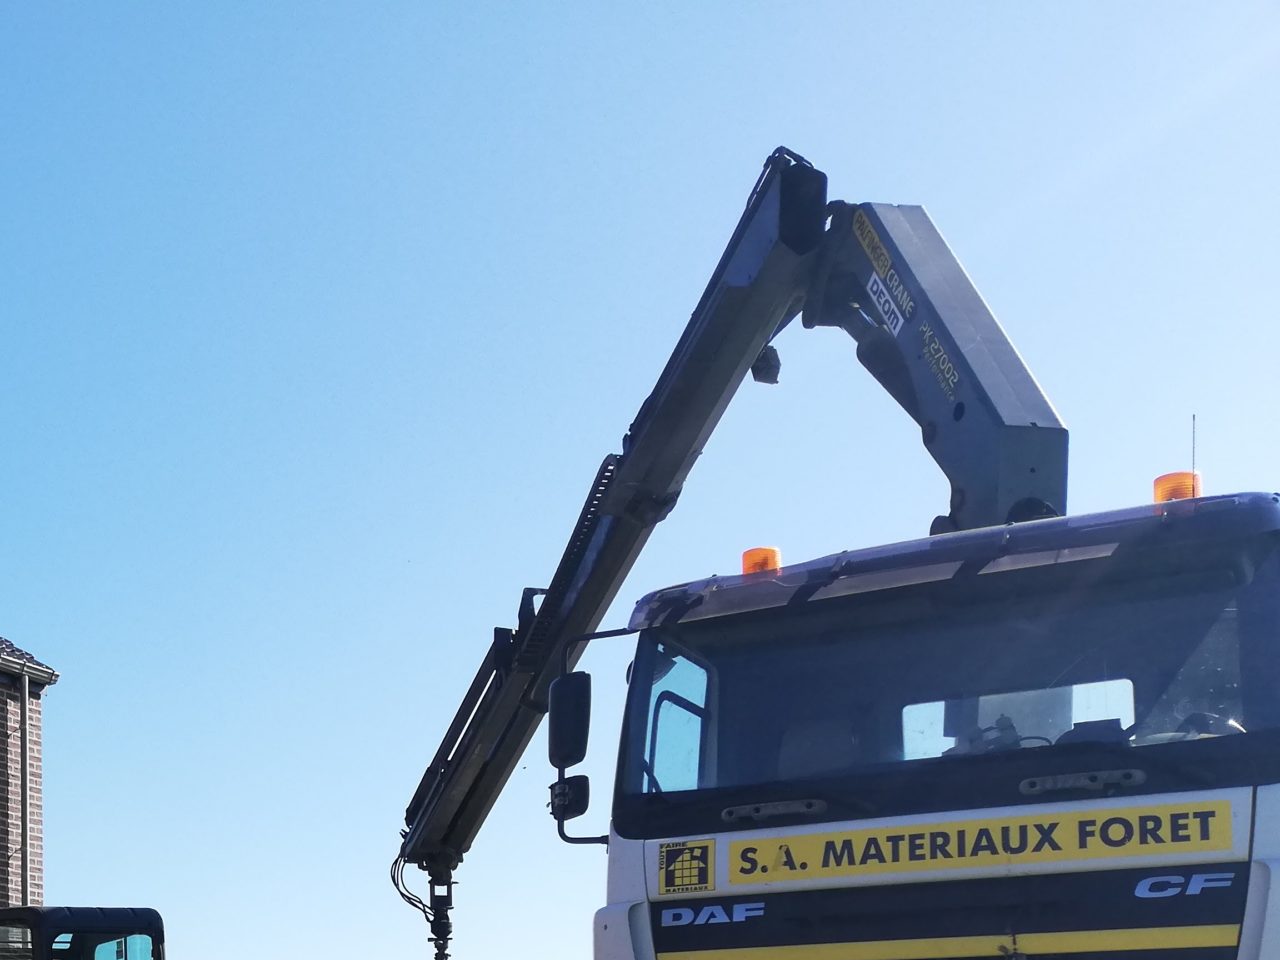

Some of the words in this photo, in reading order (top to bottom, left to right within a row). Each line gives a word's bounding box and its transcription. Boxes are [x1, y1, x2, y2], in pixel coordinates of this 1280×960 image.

[886, 269, 915, 318] CRANE
[919, 321, 935, 344] PK
[930, 341, 960, 389] 27002
[821, 821, 1062, 869] MATERIAUX
[1078, 810, 1216, 849] FORET
[665, 885, 709, 893] MATERIAUX
[1133, 872, 1236, 898] CF
[661, 902, 766, 928] DAF
